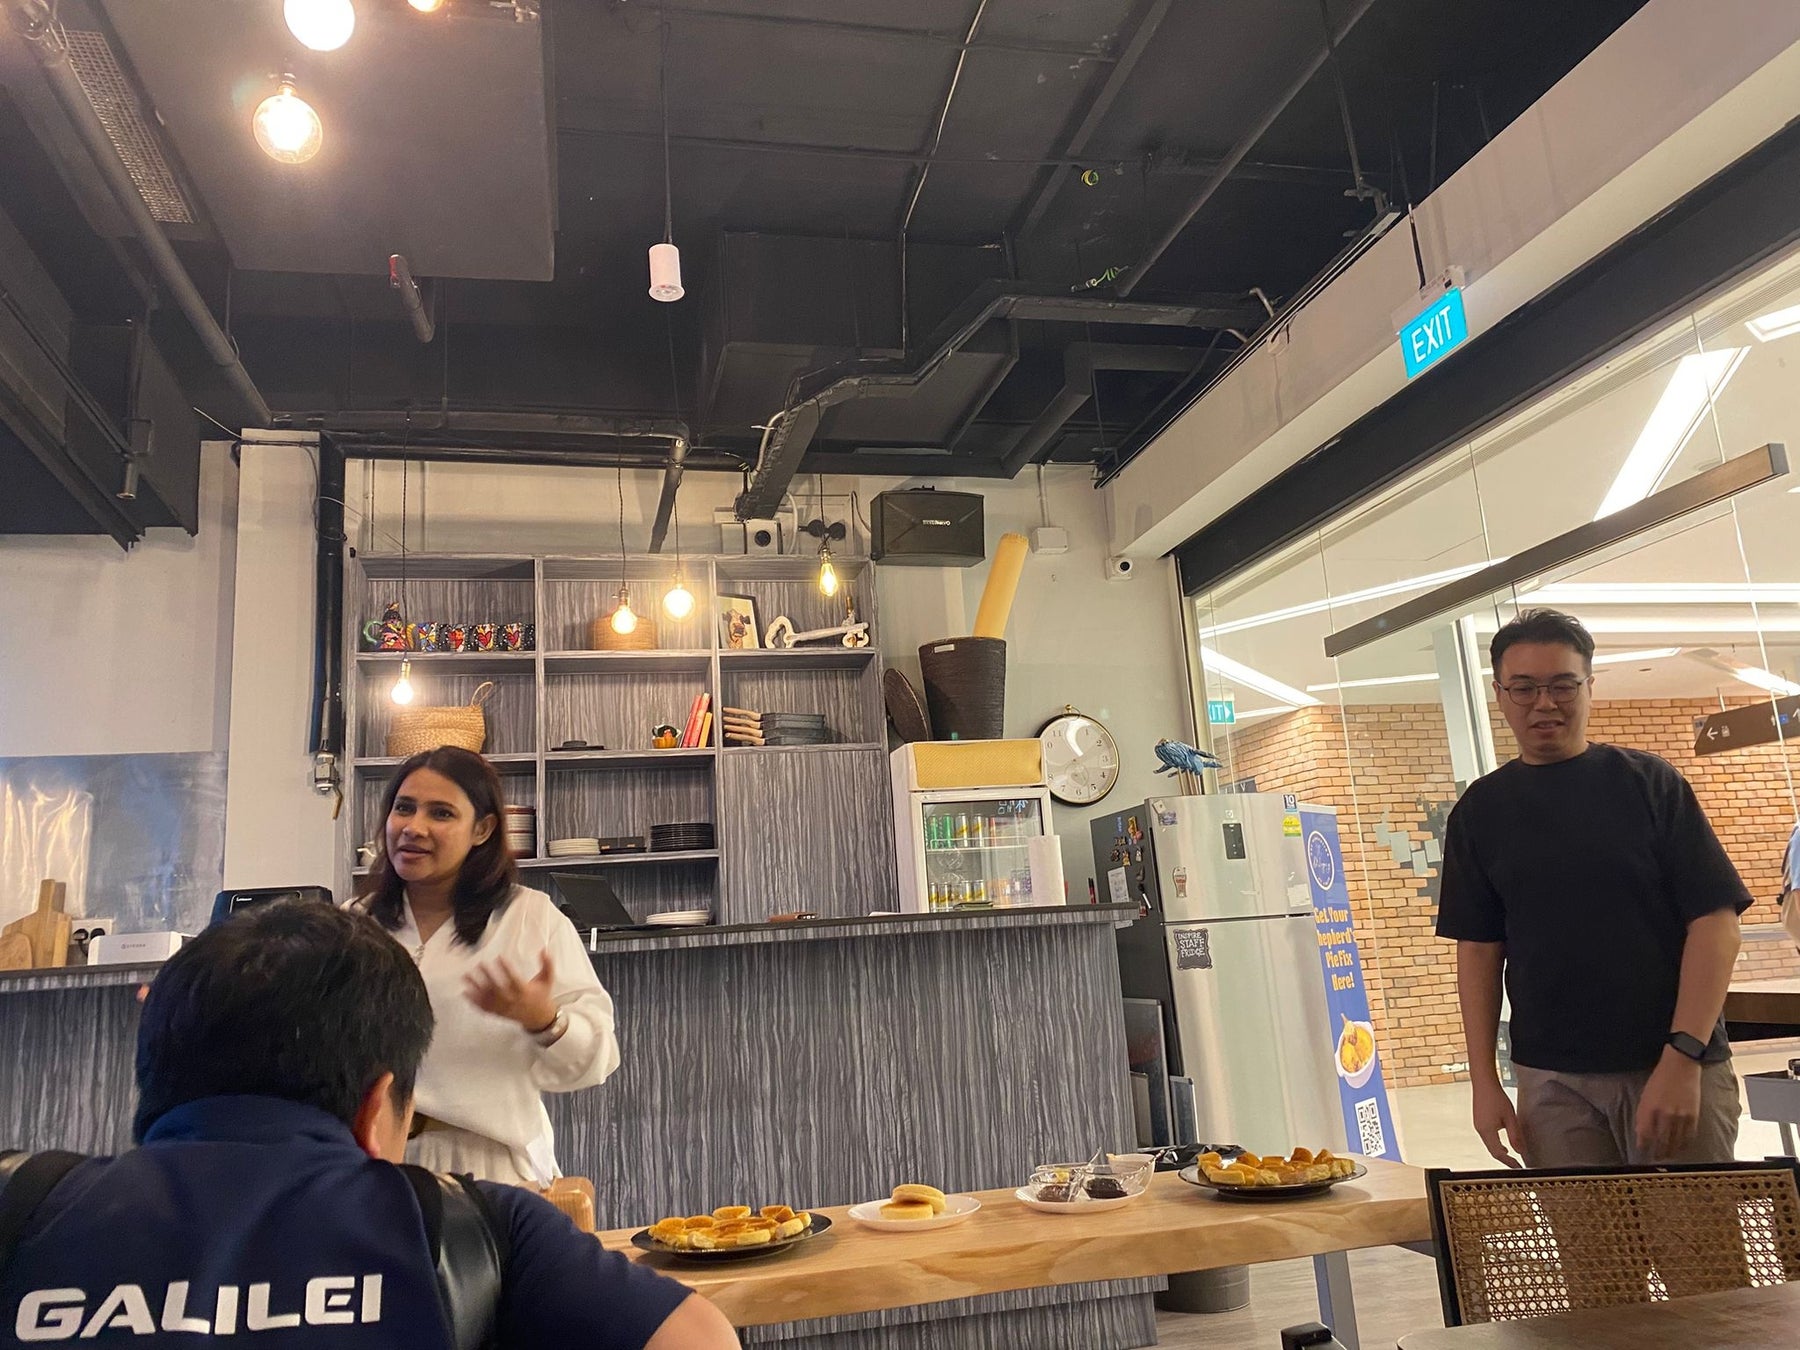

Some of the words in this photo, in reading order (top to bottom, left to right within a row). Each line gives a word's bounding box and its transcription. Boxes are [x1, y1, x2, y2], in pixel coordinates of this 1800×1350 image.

[1411, 305, 1451, 363] EXIT
[1285, 795, 1295, 804] 10
[1328, 907, 1349, 923] Your
[1180, 938, 1205, 949] STAFF
[1180, 947, 1206, 958] FRIDGE
[1331, 971, 1355, 991] Here!
[15, 1273, 383, 1342] GALILEI
